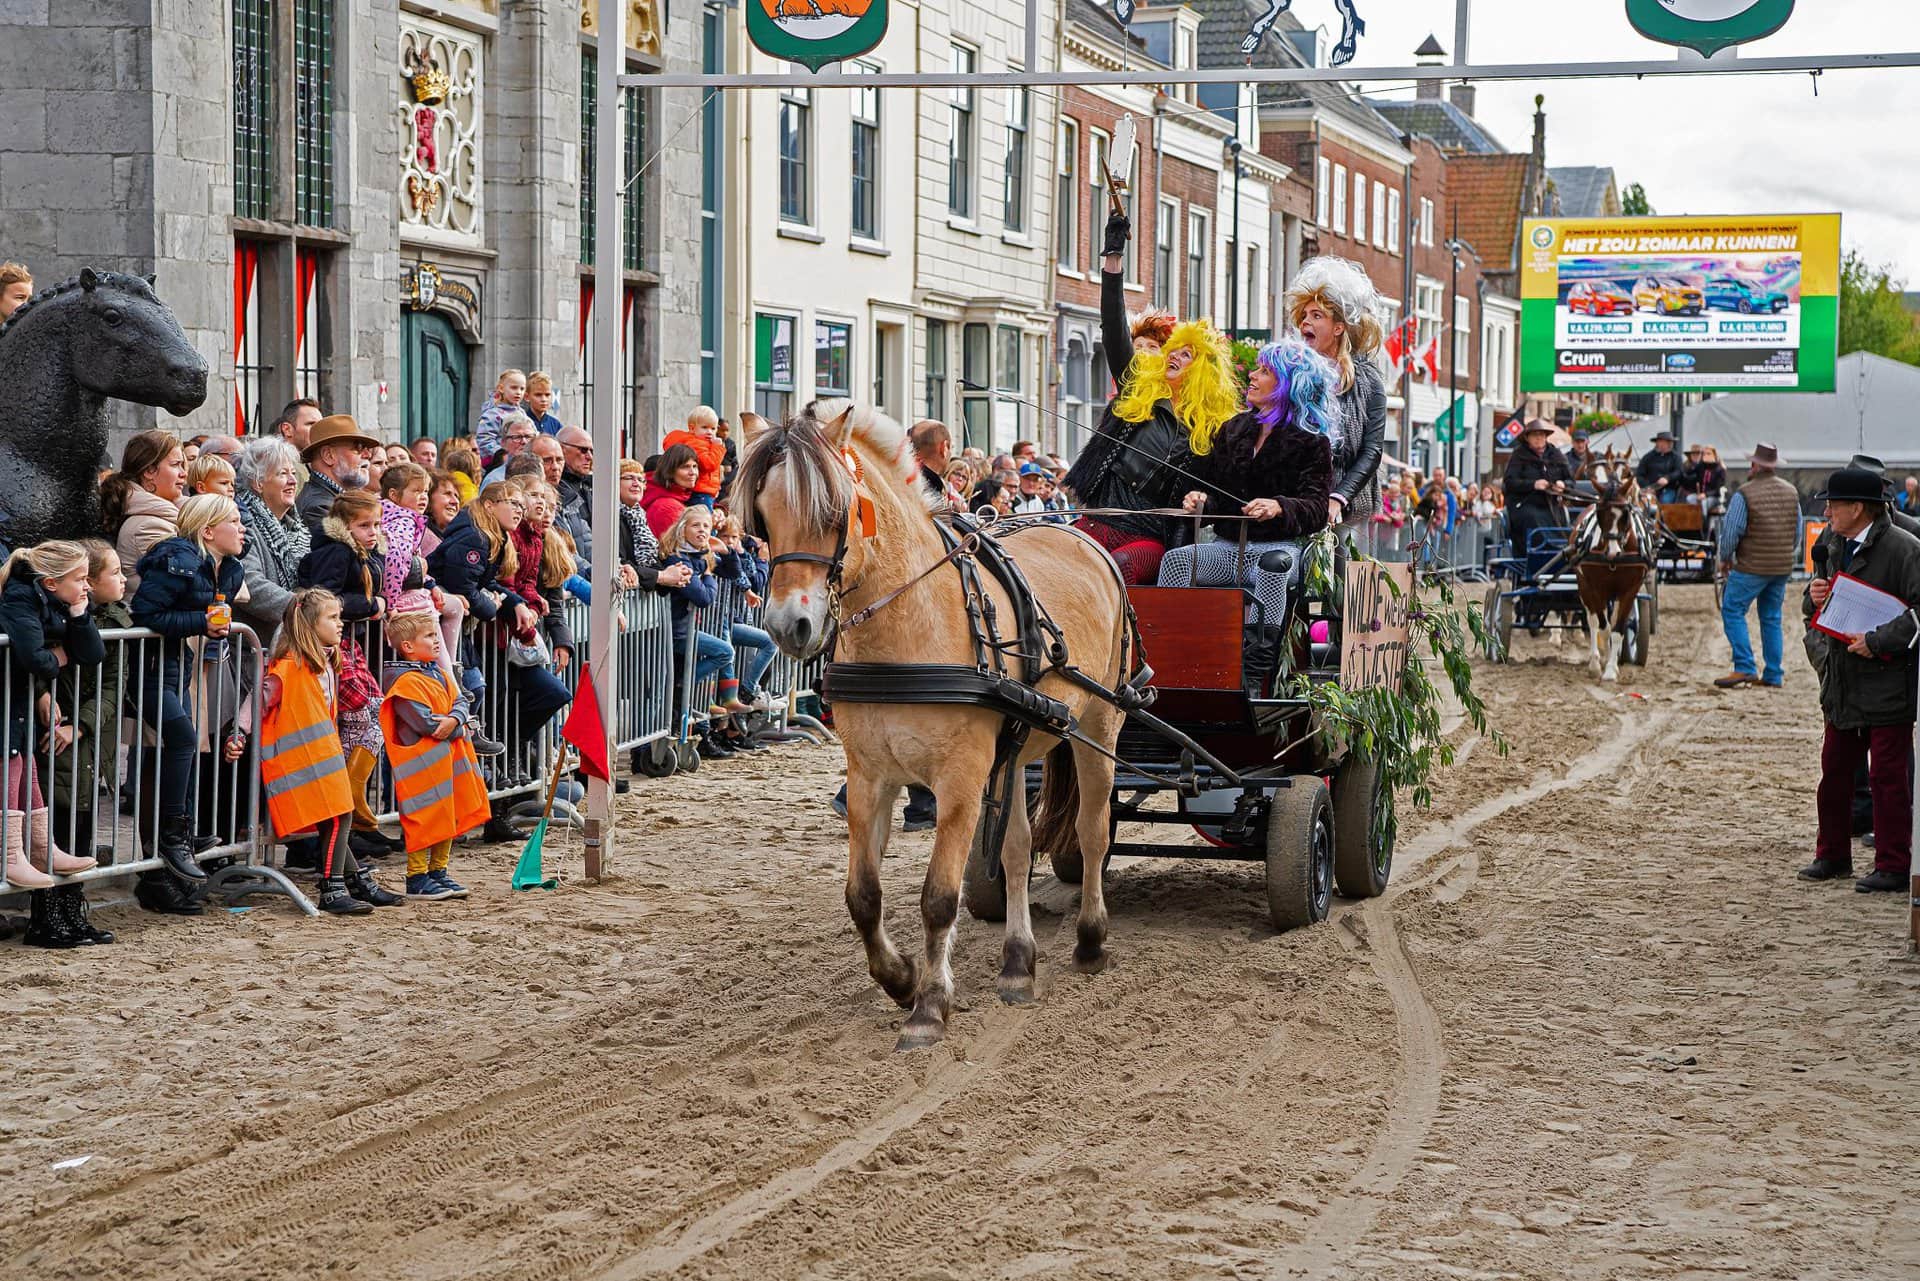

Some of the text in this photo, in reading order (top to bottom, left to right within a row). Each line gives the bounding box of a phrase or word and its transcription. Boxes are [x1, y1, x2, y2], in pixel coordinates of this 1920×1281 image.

[1563, 234, 1797, 252] HET ZOU ZOMAAR KUNNEN!
[1560, 351, 1605, 365] Crum
